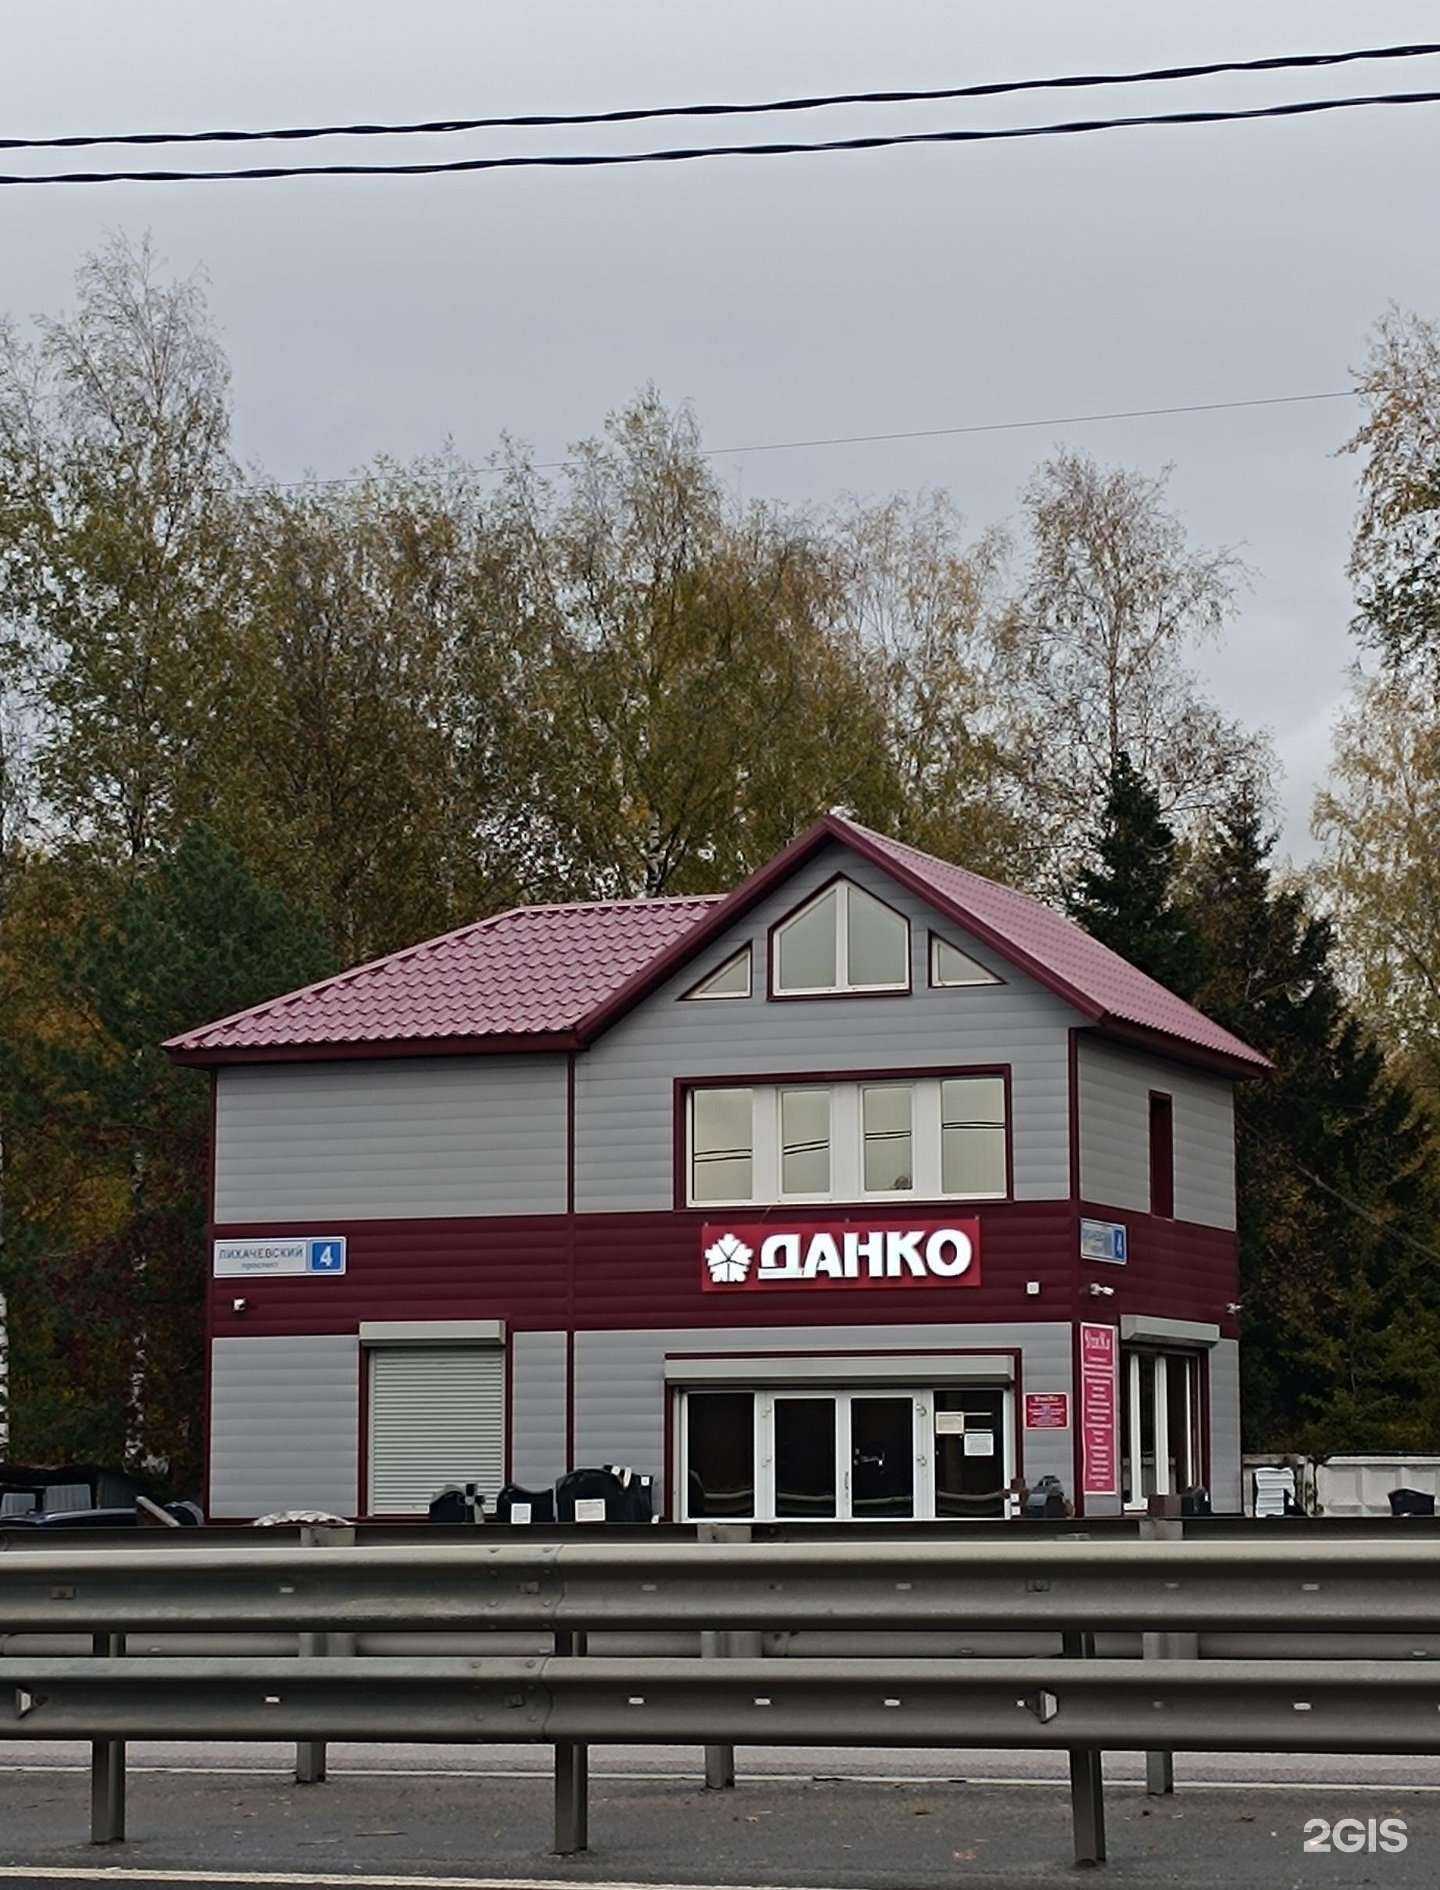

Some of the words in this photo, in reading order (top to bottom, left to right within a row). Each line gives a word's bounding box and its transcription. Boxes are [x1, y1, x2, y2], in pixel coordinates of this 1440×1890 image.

[218, 1246, 303, 1260] ЛИХАЧЕВСКИЙ
[319, 1245, 334, 1267] 4
[757, 1229, 973, 1279] ДАНКО
